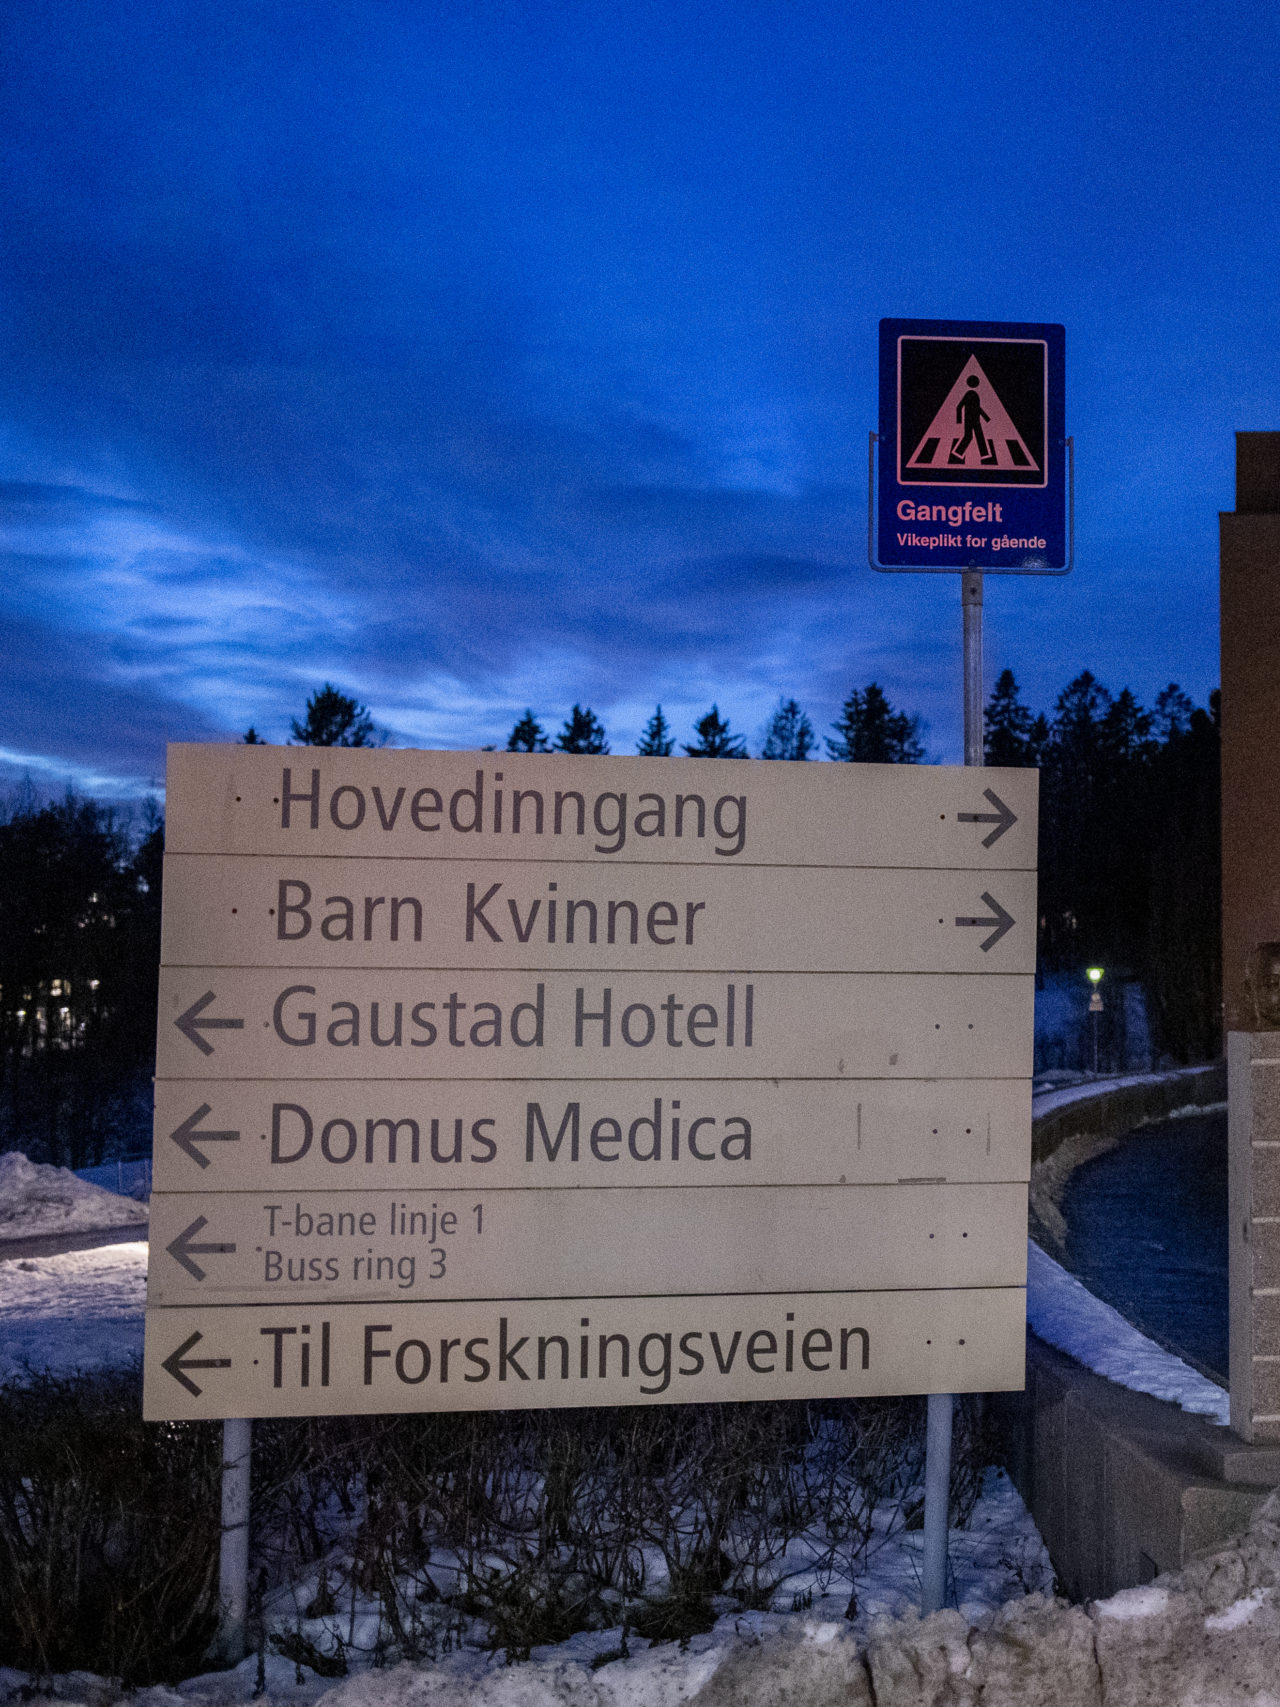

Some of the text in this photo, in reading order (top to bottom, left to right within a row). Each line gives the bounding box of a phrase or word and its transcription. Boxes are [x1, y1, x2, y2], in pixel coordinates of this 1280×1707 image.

[896, 499, 1003, 527] Gangfelt
[896, 532, 1047, 551] Vikeplikt for gående
[279, 767, 748, 856] Hovedinngang
[276, 879, 706, 946] Barn Kvinner
[272, 982, 754, 1048] Gaustad Hotell
[270, 1097, 753, 1164] Domus Medica
[263, 1201, 486, 1245] T-bane linje 1
[264, 1247, 447, 1290] Buss ring 3
[260, 1311, 872, 1395] Til Forskningsveien
